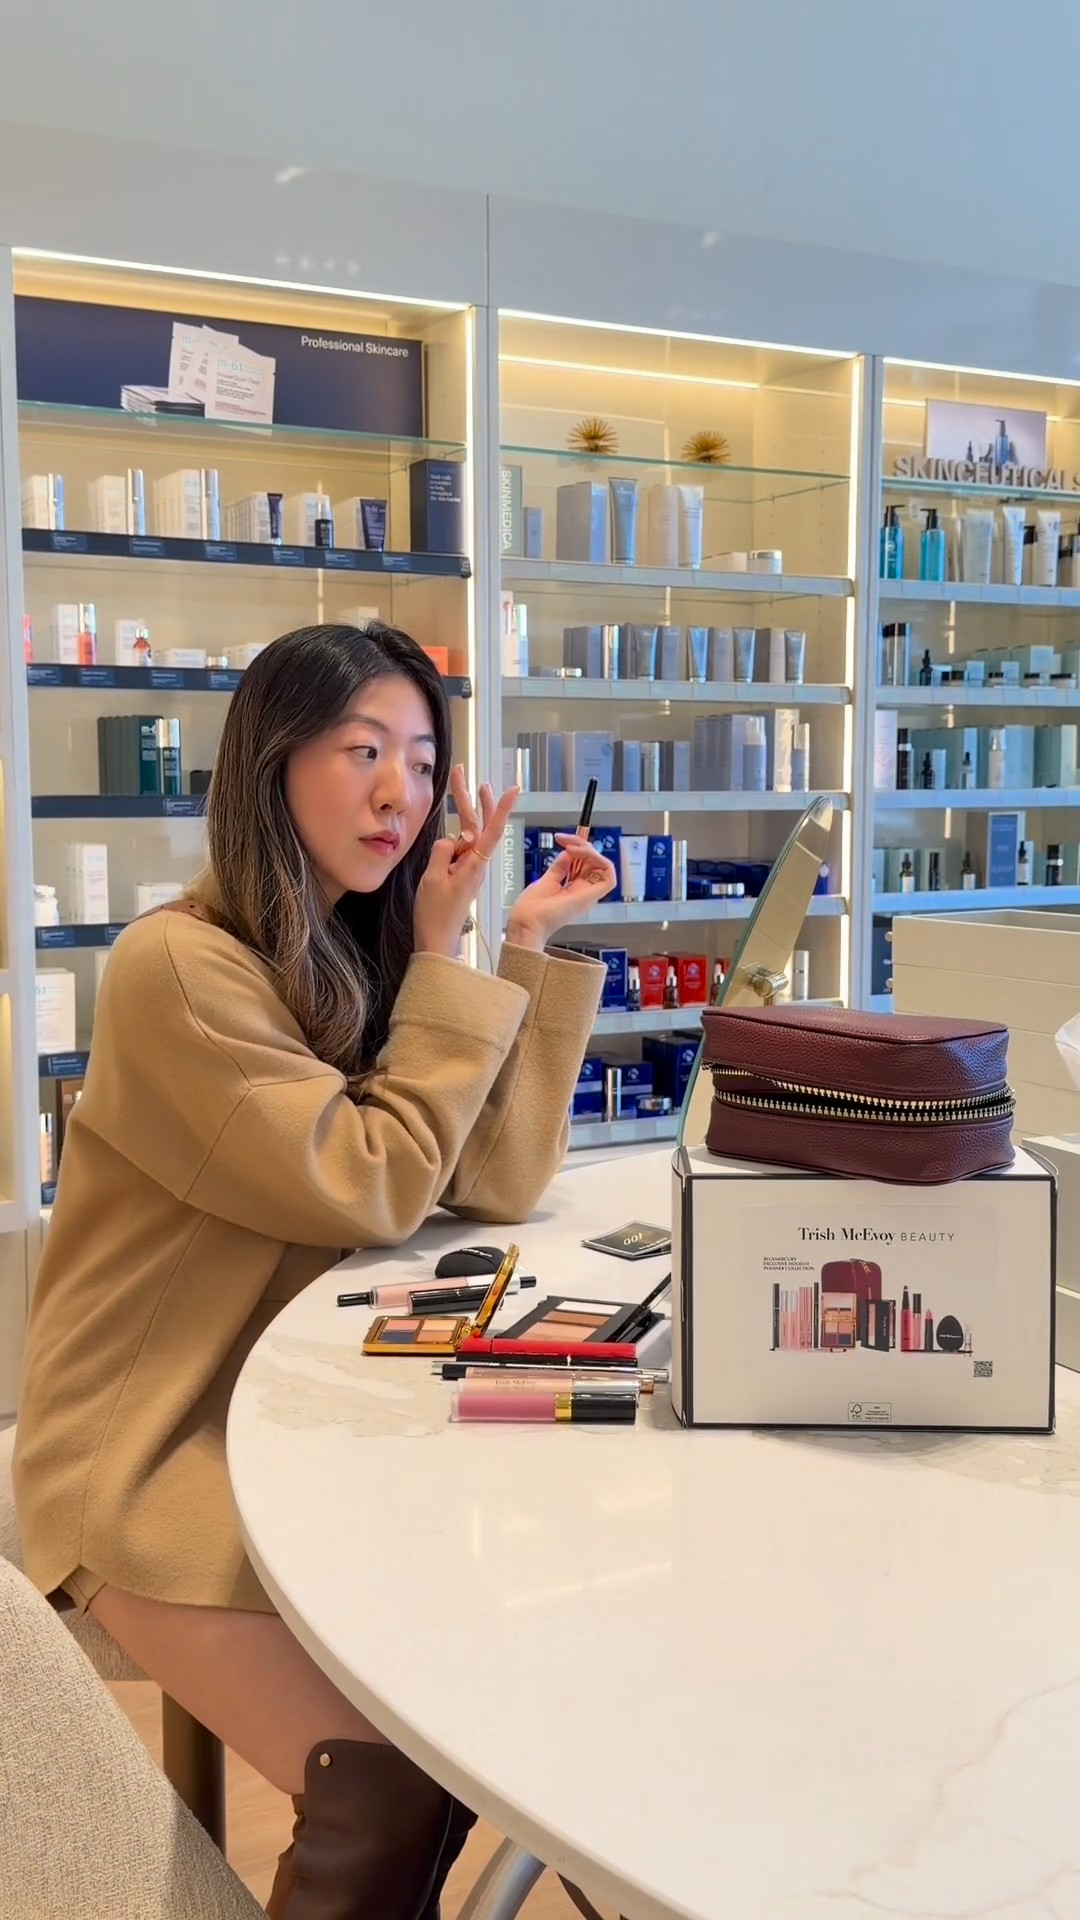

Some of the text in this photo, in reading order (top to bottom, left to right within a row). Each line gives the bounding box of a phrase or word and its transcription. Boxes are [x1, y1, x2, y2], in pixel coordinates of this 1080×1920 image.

[301, 335, 409, 358] Professional Skincare
[501, 468, 513, 550] SKINMEDICA
[503, 838, 514, 895] CLINICAL
[798, 1227, 955, 1246] Trish McEvoy BEAUTY
